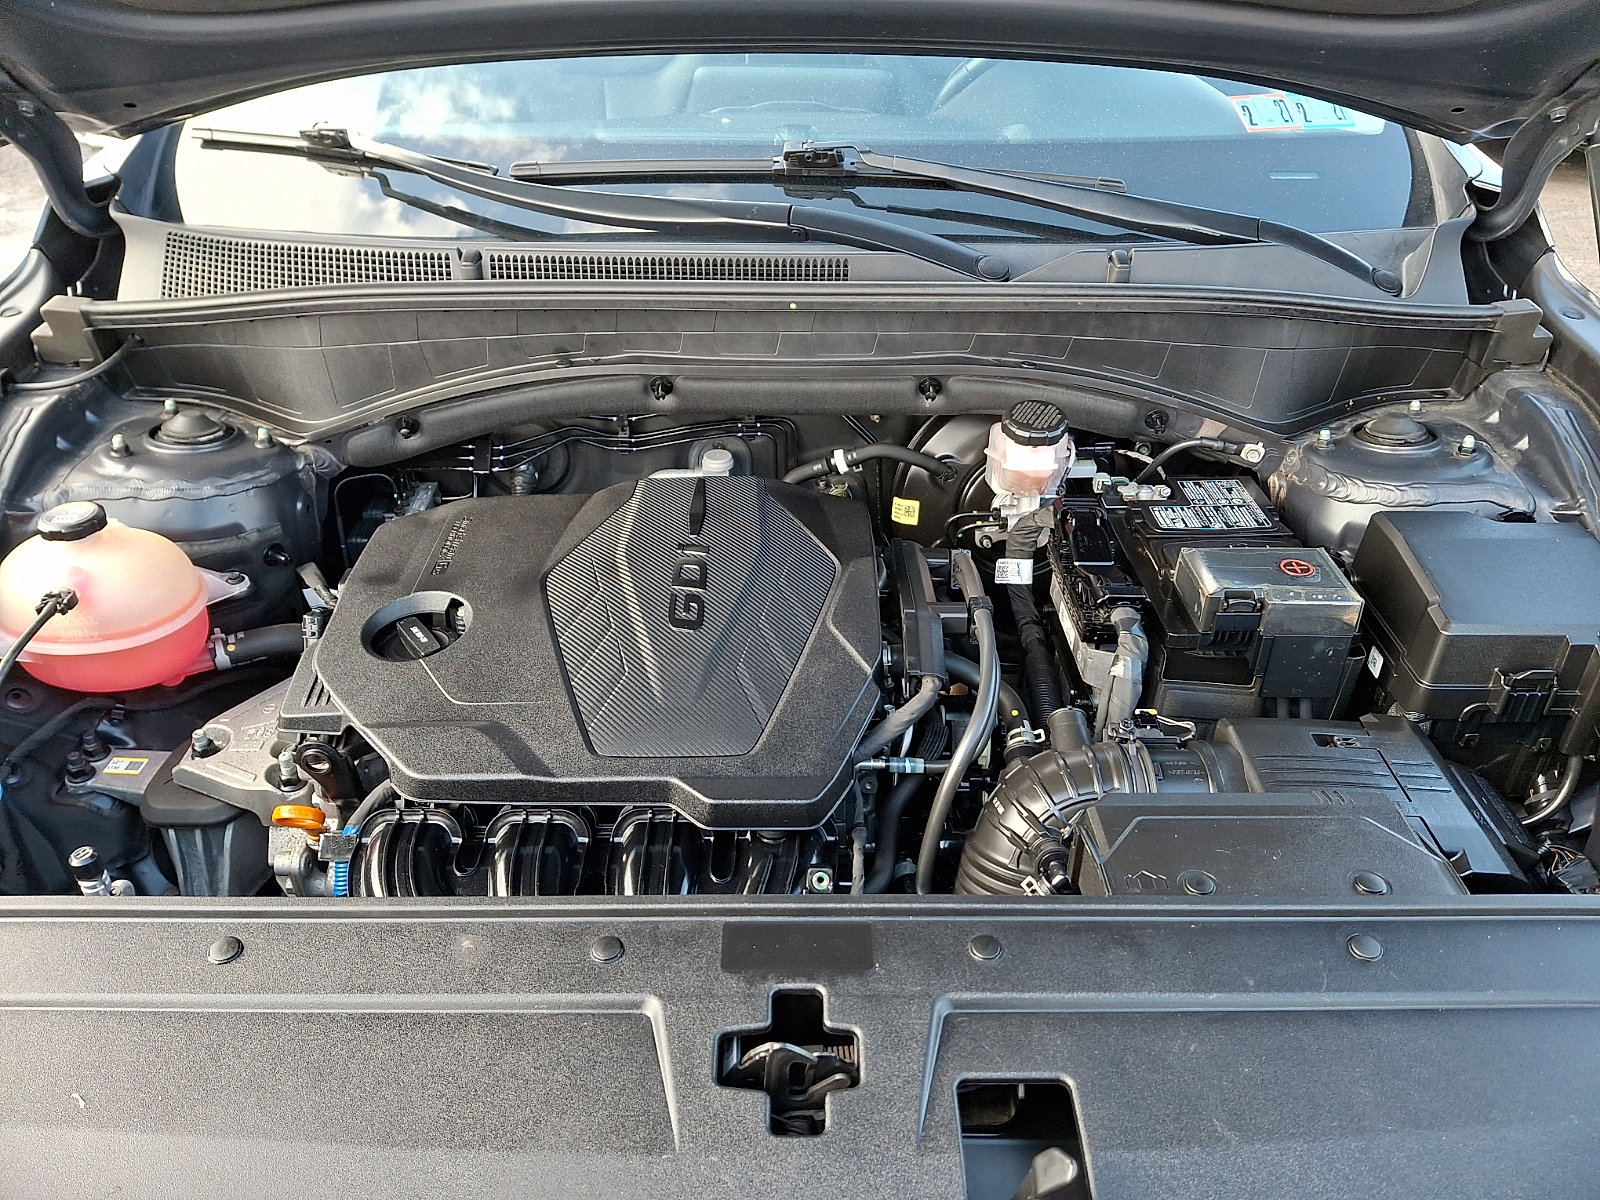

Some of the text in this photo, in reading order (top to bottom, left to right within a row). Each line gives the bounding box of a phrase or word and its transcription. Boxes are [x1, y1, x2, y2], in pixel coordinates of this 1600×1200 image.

[1241, 104, 1258, 126] 2
[1295, 102, 1312, 123] 2
[668, 543, 710, 632] GDi
